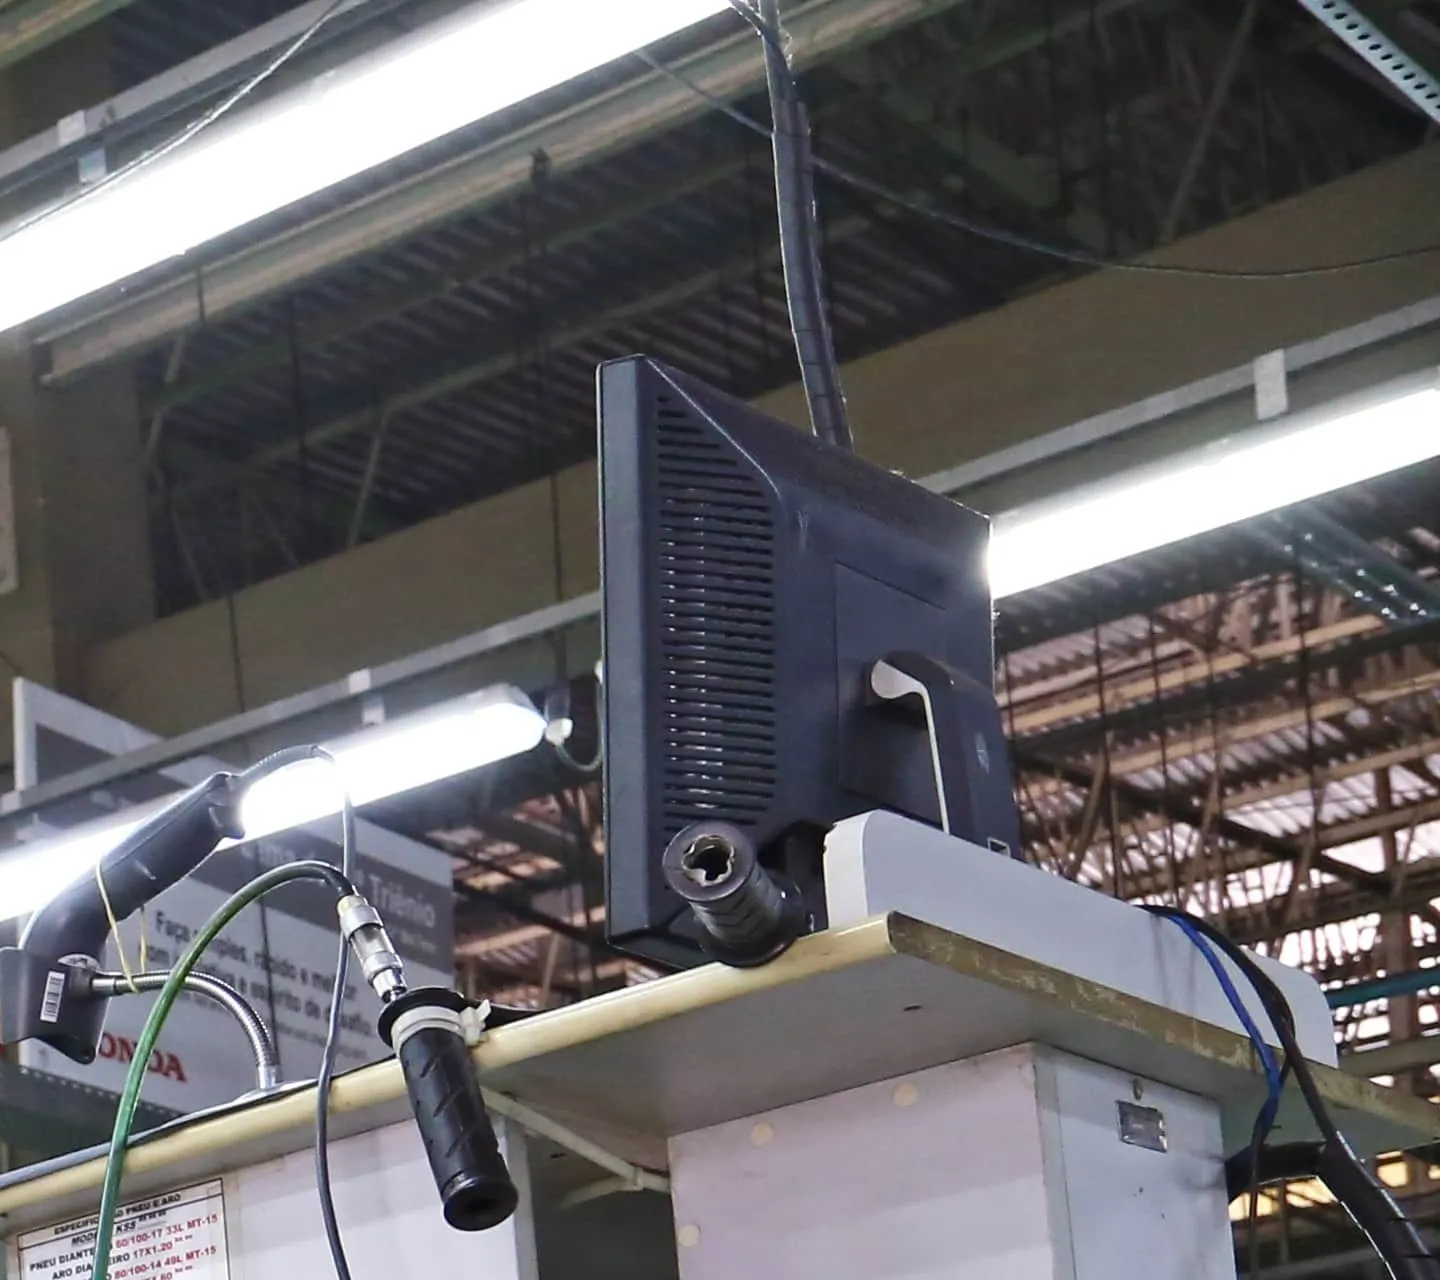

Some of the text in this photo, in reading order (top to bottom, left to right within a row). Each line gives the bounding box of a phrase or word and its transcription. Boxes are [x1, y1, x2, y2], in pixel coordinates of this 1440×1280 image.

[126, 1203, 150, 1215] PNEU
[161, 1193, 181, 1205] ARO
[30, 1257, 56, 1271] PNEU
[166, 1224, 184, 1235] 33L
[187, 1214, 218, 1229] MT-15
[186, 1245, 217, 1260] MT-15
[52, 1268, 73, 1280] ARO
